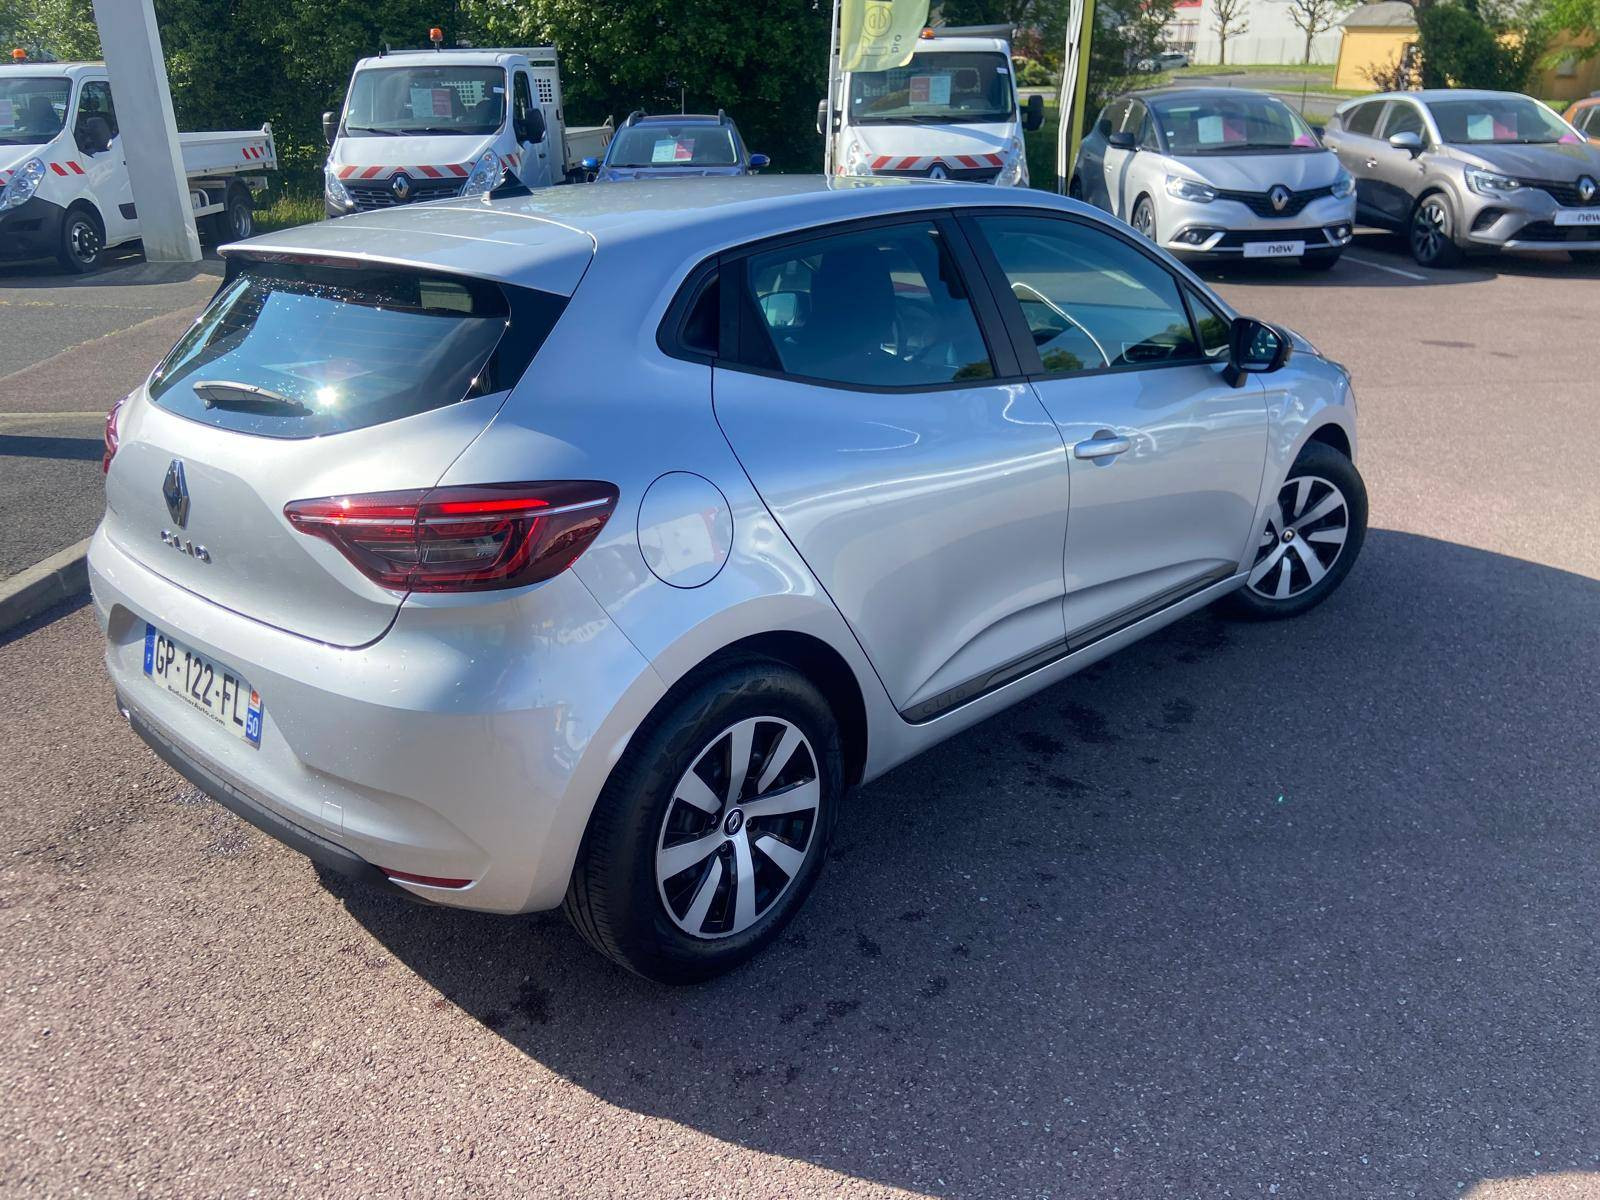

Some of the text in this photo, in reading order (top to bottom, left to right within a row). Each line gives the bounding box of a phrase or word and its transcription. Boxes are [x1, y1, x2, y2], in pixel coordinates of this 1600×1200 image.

[891, 34, 902, 54] pro
[160, 529, 212, 564] CLIO
[155, 634, 244, 728] GP-122-FL
[246, 712, 259, 738] 50
